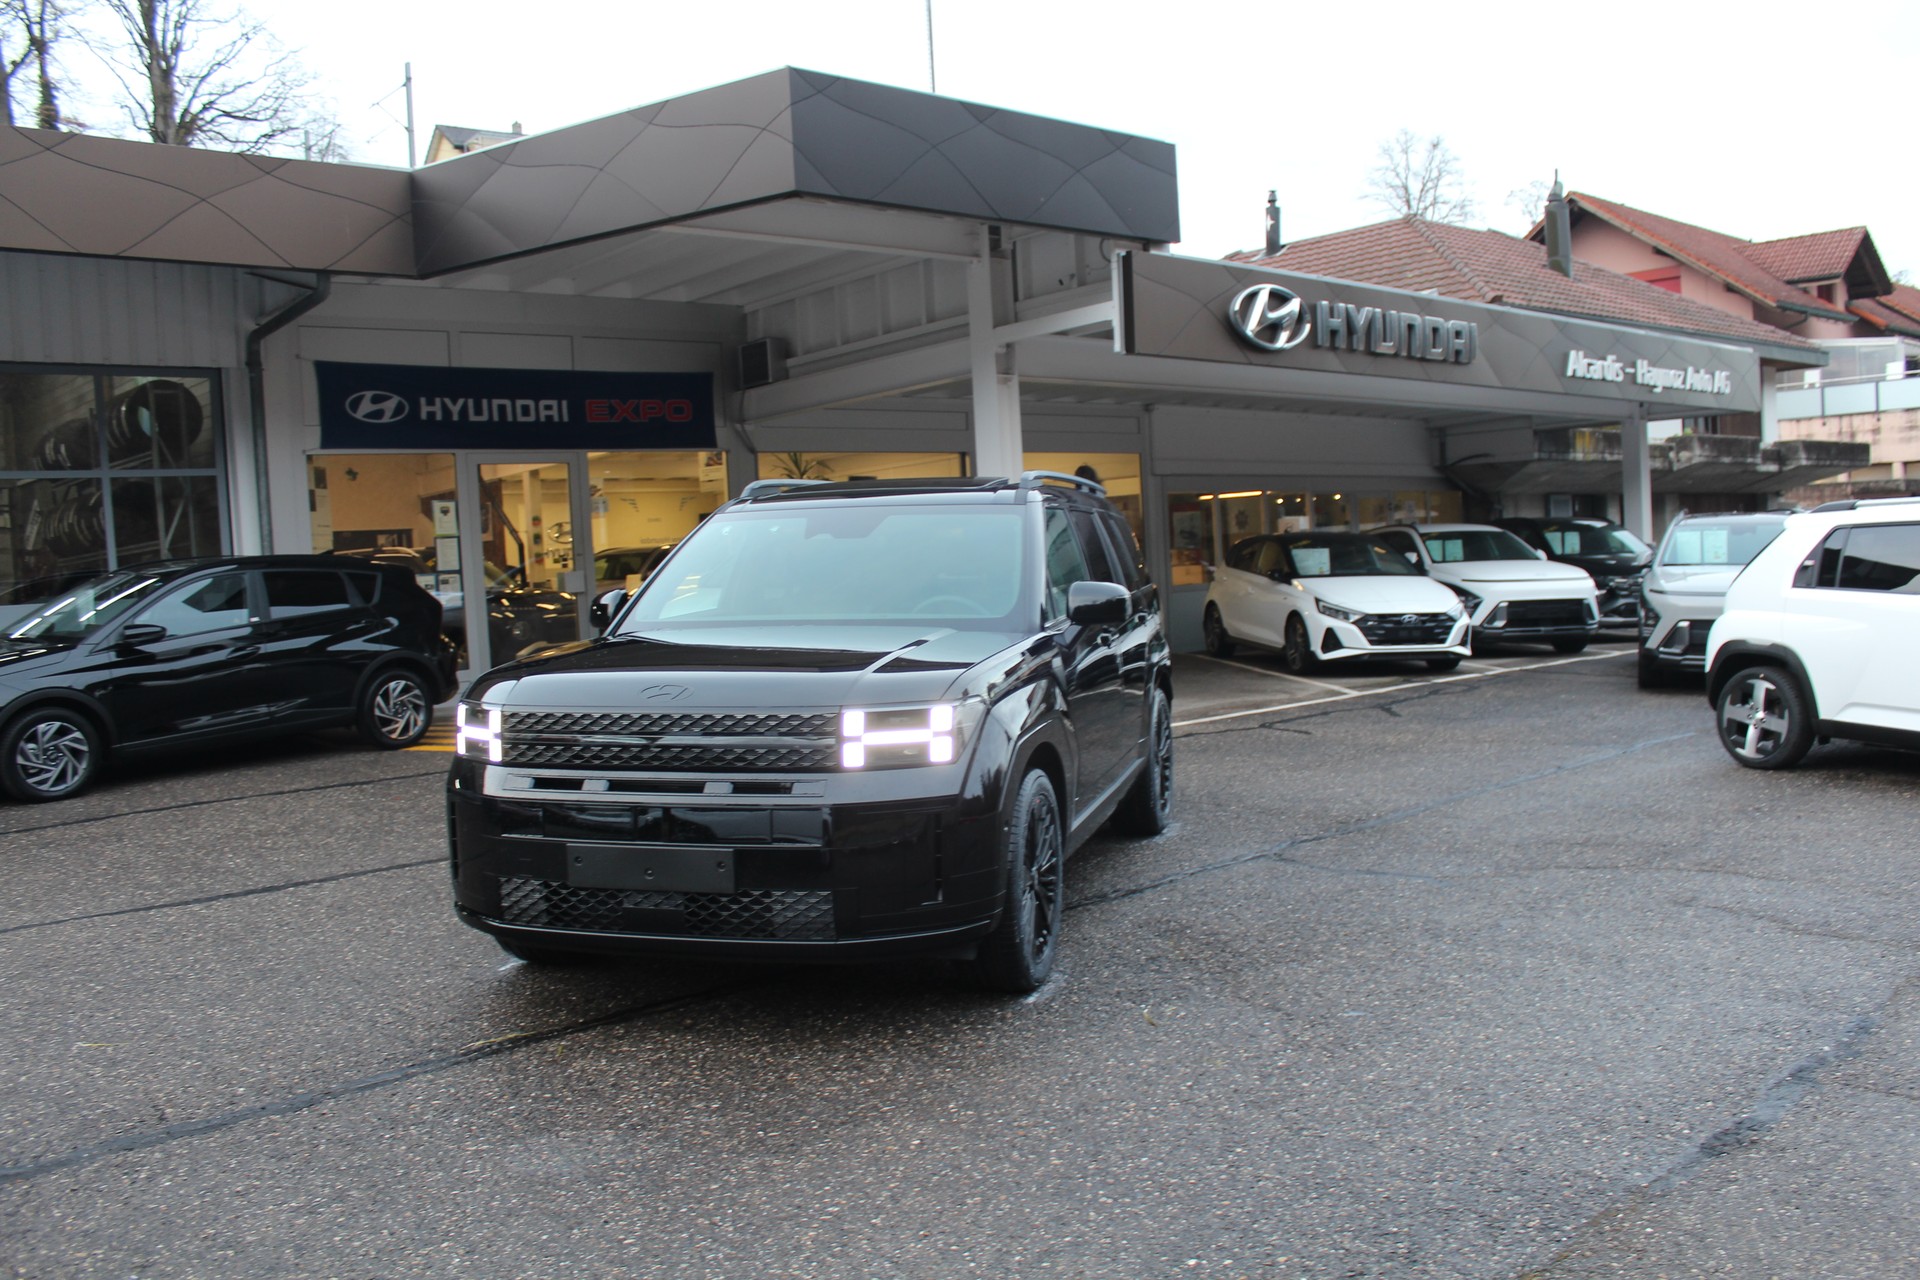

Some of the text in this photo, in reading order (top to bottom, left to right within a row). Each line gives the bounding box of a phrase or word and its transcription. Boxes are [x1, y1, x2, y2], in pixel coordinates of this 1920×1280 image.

[1316, 299, 1478, 363] HYUNDAI
[420, 397, 693, 422] HYUNDAI EXPO
